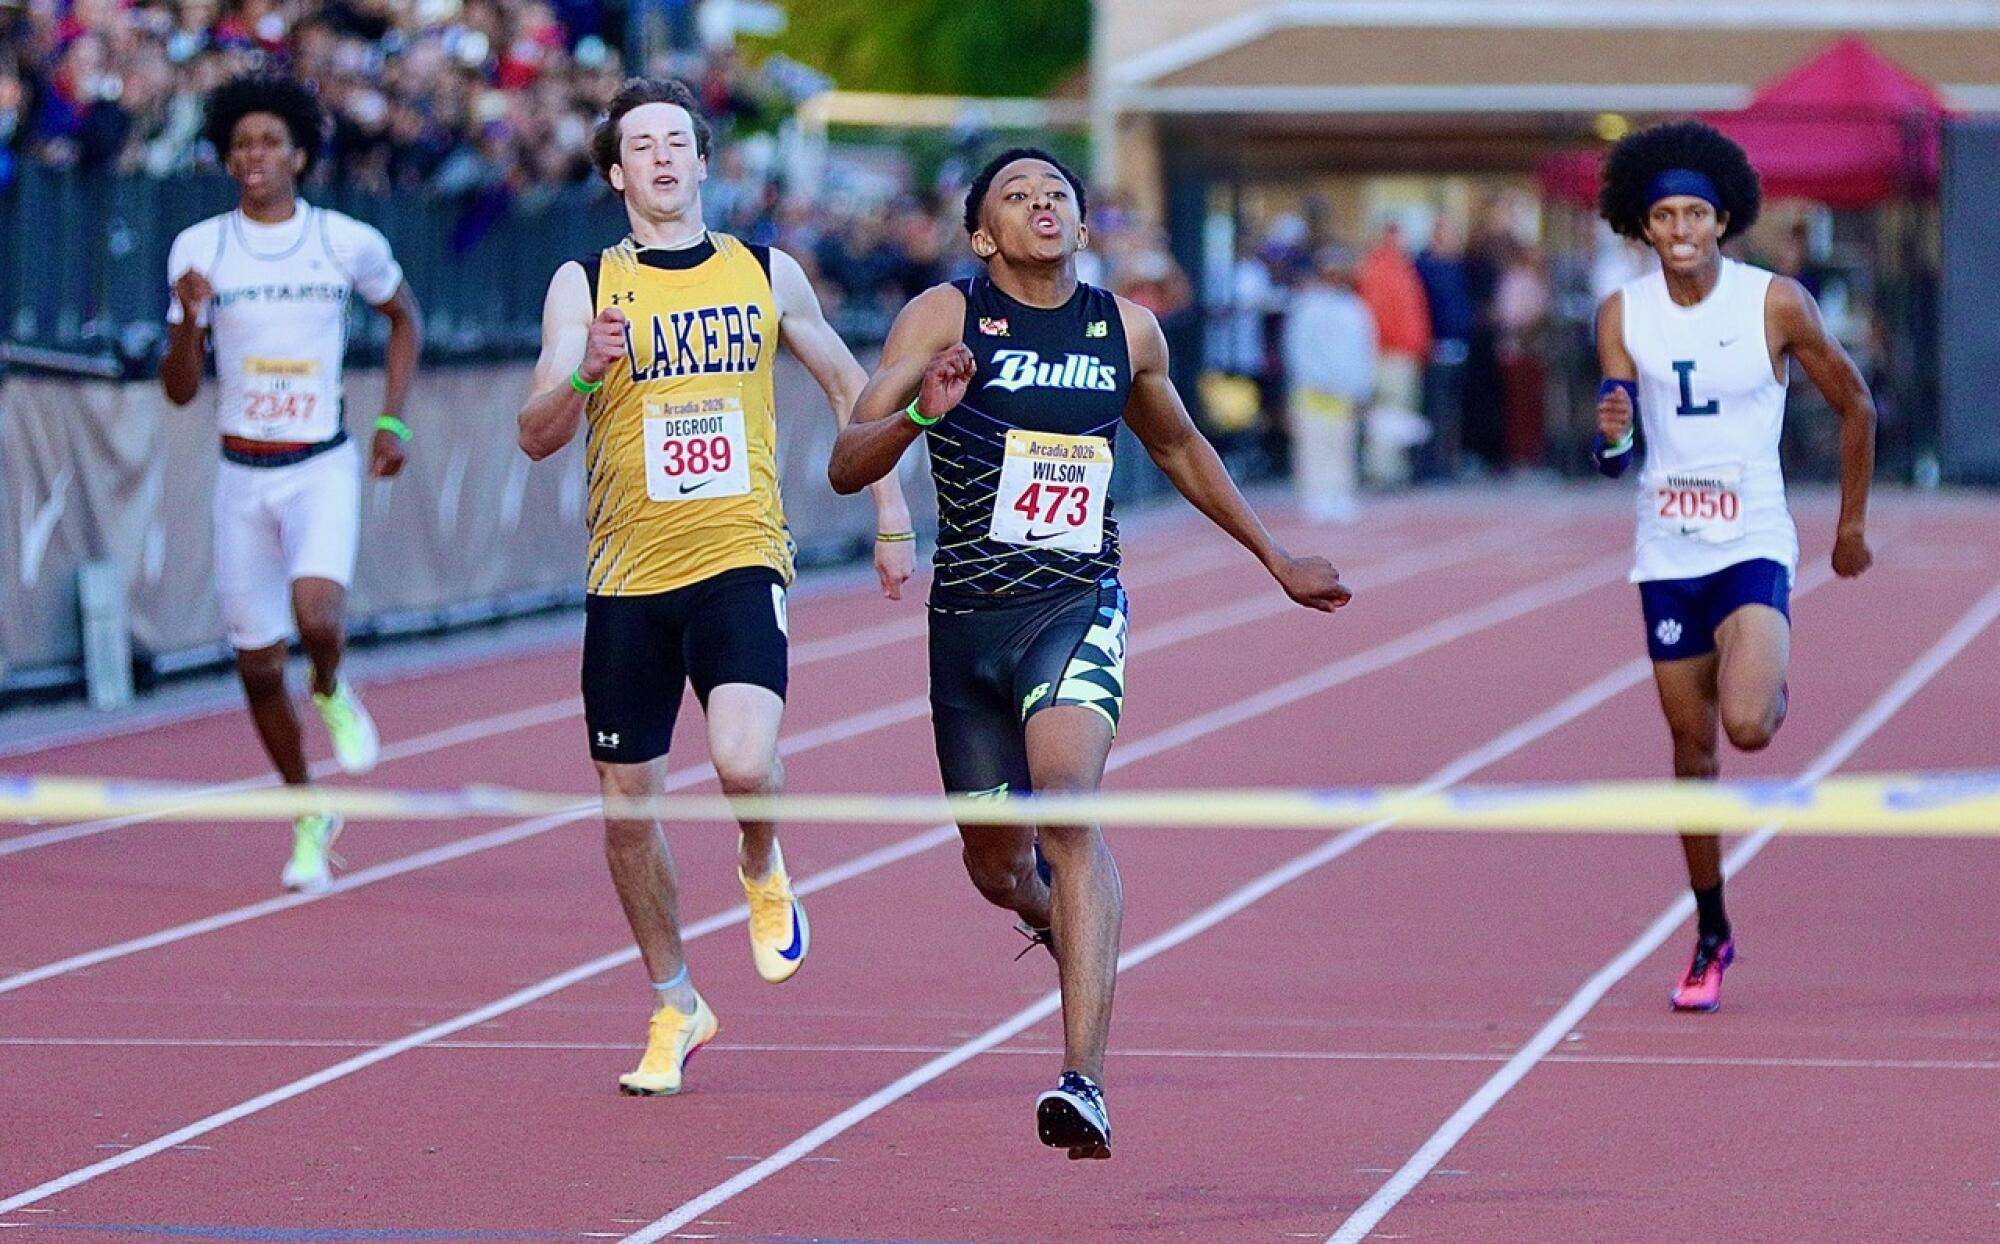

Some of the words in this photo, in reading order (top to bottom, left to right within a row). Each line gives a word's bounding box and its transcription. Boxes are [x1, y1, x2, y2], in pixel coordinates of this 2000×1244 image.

[624, 305, 763, 382] LAKERS
[1085, 320, 1108, 338] NB
[983, 349, 1117, 392] Bullis
[1672, 360, 1720, 415] L
[244, 393, 317, 420] 2347
[664, 401, 699, 415] Arcadia
[702, 399, 724, 412] 2026
[665, 416, 724, 437] DEGROOT
[663, 435, 731, 477] 389
[1029, 441, 1069, 459] Arcadia
[1071, 444, 1095, 459] 2026
[1032, 461, 1087, 484] WILSON
[1013, 482, 1090, 527] 473
[1658, 489, 1739, 521] 2050
